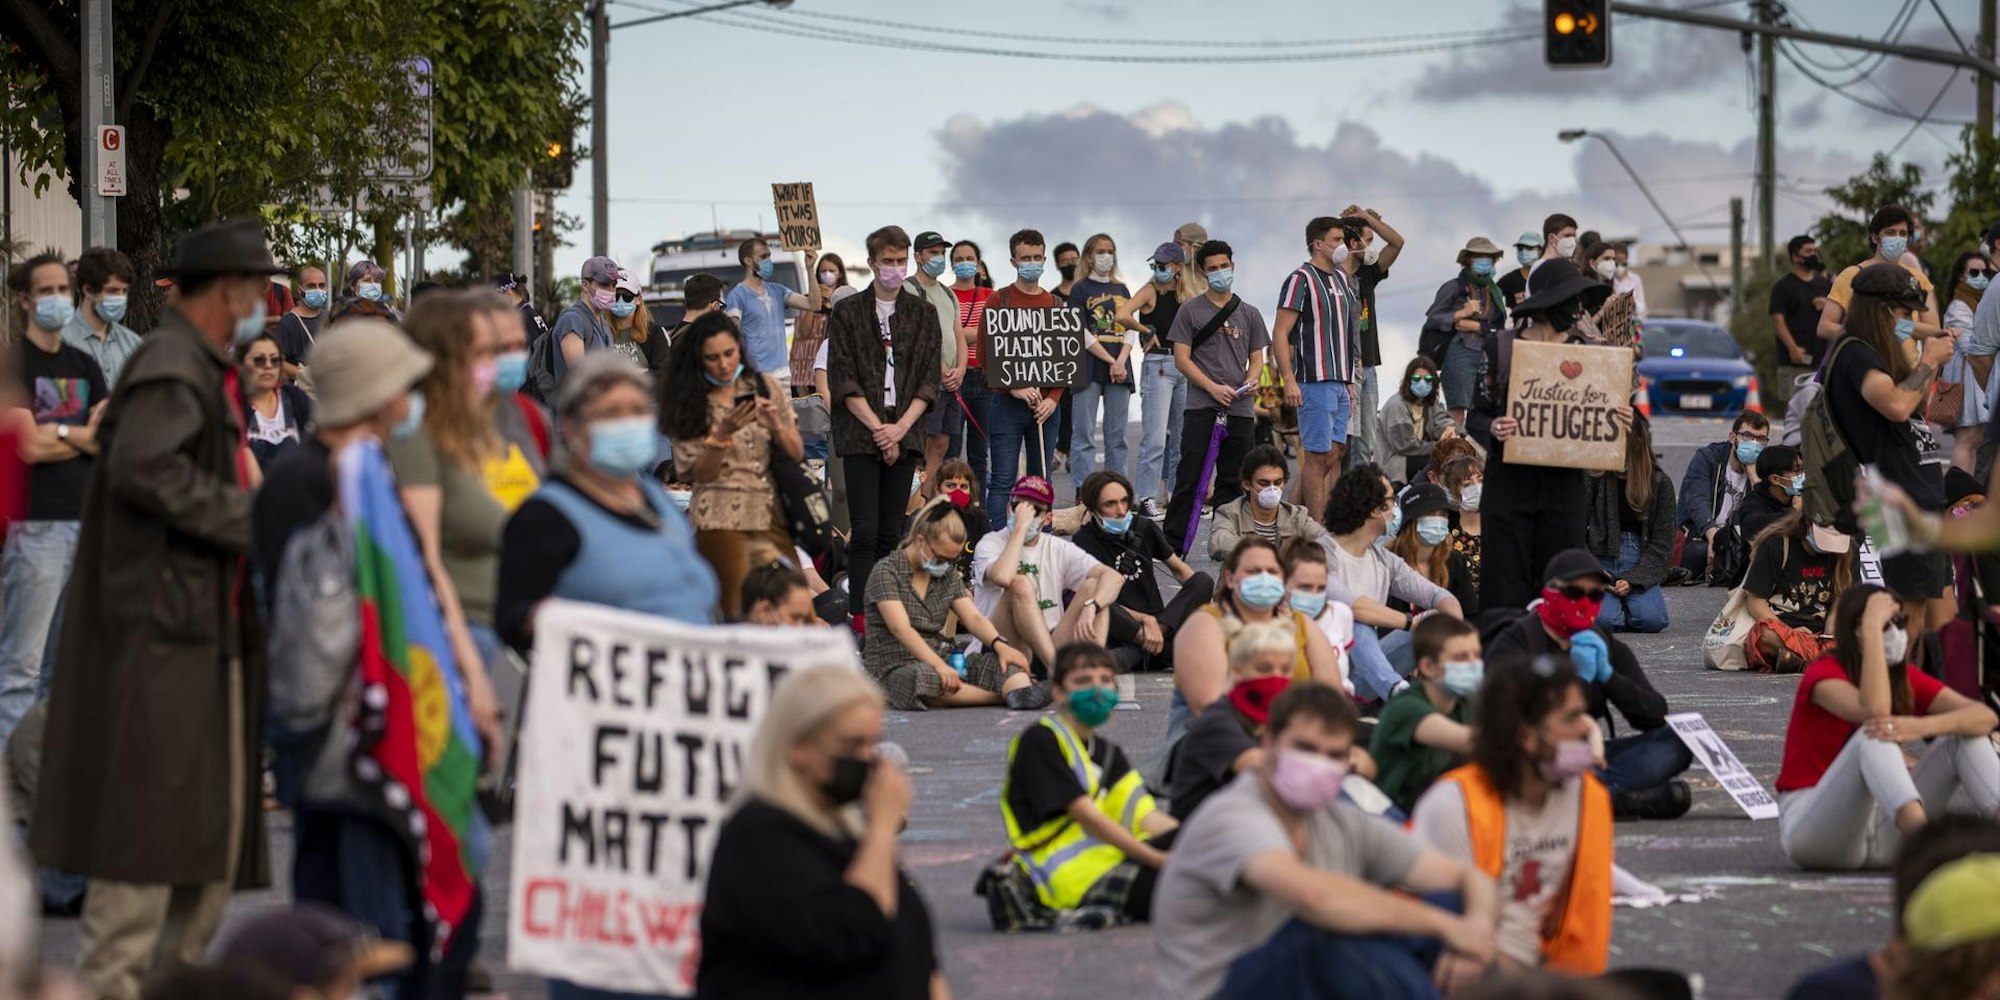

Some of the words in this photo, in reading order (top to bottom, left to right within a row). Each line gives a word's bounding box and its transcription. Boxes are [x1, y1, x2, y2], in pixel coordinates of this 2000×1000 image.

[106, 130, 117, 149] C
[104, 176, 122, 184] TIMES
[775, 184, 799, 202] WHAT
[801, 183, 810, 202] IF
[778, 205, 789, 222] IT
[789, 204, 813, 221] WAS
[779, 225, 807, 248] YOUR
[985, 307, 1081, 335] BOUNDLESS
[994, 335, 1053, 358] PLAINS
[1056, 336, 1080, 357] TO
[1000, 360, 1077, 386] SHARE?
[1519, 378, 1579, 402] Justice
[1580, 384, 1609, 405] for
[1511, 400, 1621, 442] REFUGEES
